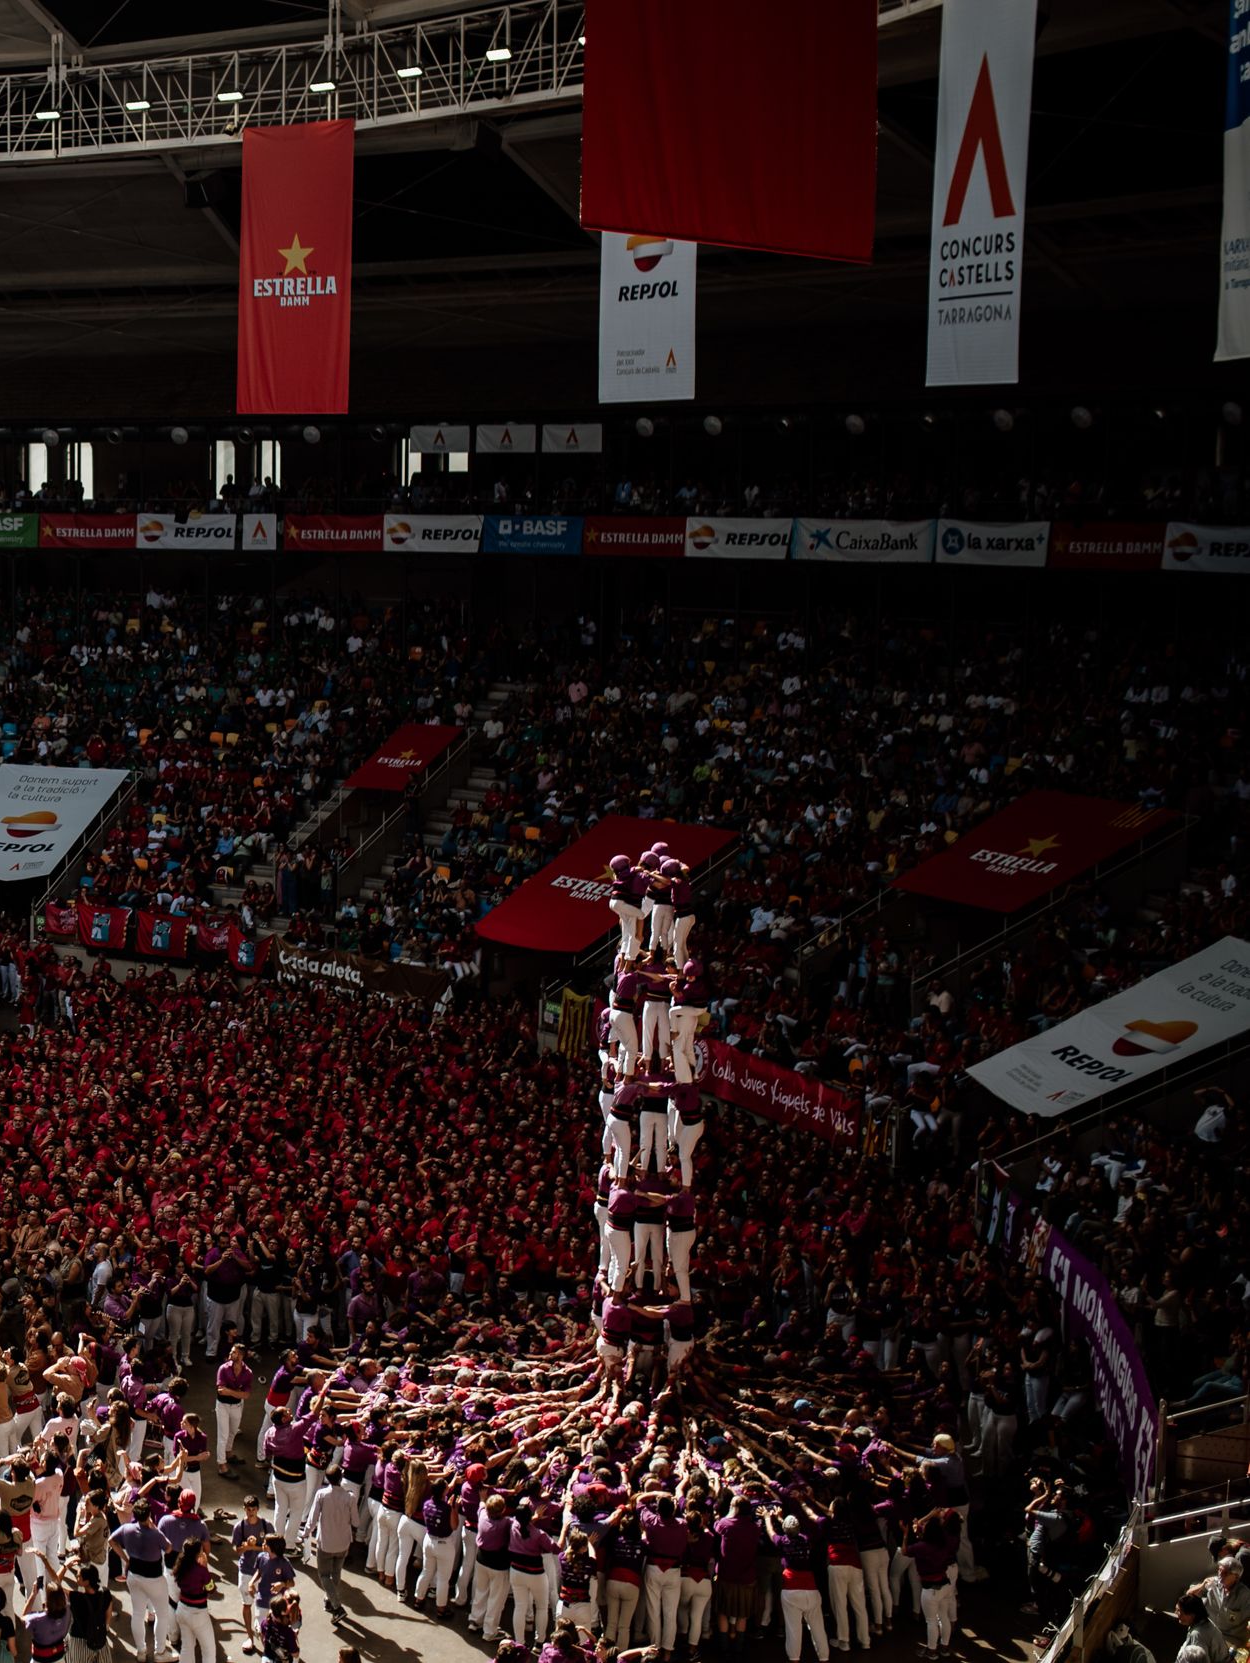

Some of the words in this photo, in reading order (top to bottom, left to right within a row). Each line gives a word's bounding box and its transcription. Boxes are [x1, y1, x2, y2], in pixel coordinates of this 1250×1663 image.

[940, 231, 1015, 261] CONCURS
[939, 260, 1014, 288] CASTELLS
[253, 275, 338, 298] ESTRELLA
[618, 280, 679, 303] REPSOL
[279, 296, 311, 308] DAMM
[937, 303, 1012, 326] TARRAGONA
[55, 527, 103, 538] ESTRELLA
[104, 527, 135, 538] DAMM
[173, 526, 233, 539] REPSOL
[300, 529, 350, 541] ESTRELLA
[350, 529, 382, 540] DAMM
[421, 528, 482, 541] REPSOL
[522, 519, 568, 537] BASF
[600, 531, 649, 545] ESTRELLA
[651, 532, 684, 545] DAMM
[725, 532, 790, 546] REPSOL
[835, 530, 919, 551] CaixaBank
[967, 532, 982, 549] la
[1067, 540, 1124, 555] ESTRELLA
[1125, 541, 1163, 555] DAMM
[1209, 541, 1250, 557] REP
[18, 775, 60, 785] Donem
[62, 777, 99, 787] suport
[24, 784, 35, 792] la
[38, 785, 80, 794] tradició
[7, 791, 19, 800] la
[21, 793, 62, 803] cultura
[968, 848, 1060, 875] ESTRELLA
[984, 864, 1019, 876] DAMM
[549, 874, 615, 897] ESTREL
[569, 889, 602, 902] DAMM
[278, 949, 319, 974] Cada
[1198, 973, 1214, 982] a
[1208, 975, 1227, 988] la
[1177, 982, 1195, 994] la
[1190, 990, 1237, 1012] cultura
[1051, 1045, 1134, 1083] REPSOL
[711, 1058, 737, 1086] Colla
[740, 1068, 768, 1097] Joves
[770, 1078, 812, 1116] Xiquets
[812, 1104, 826, 1123] de
